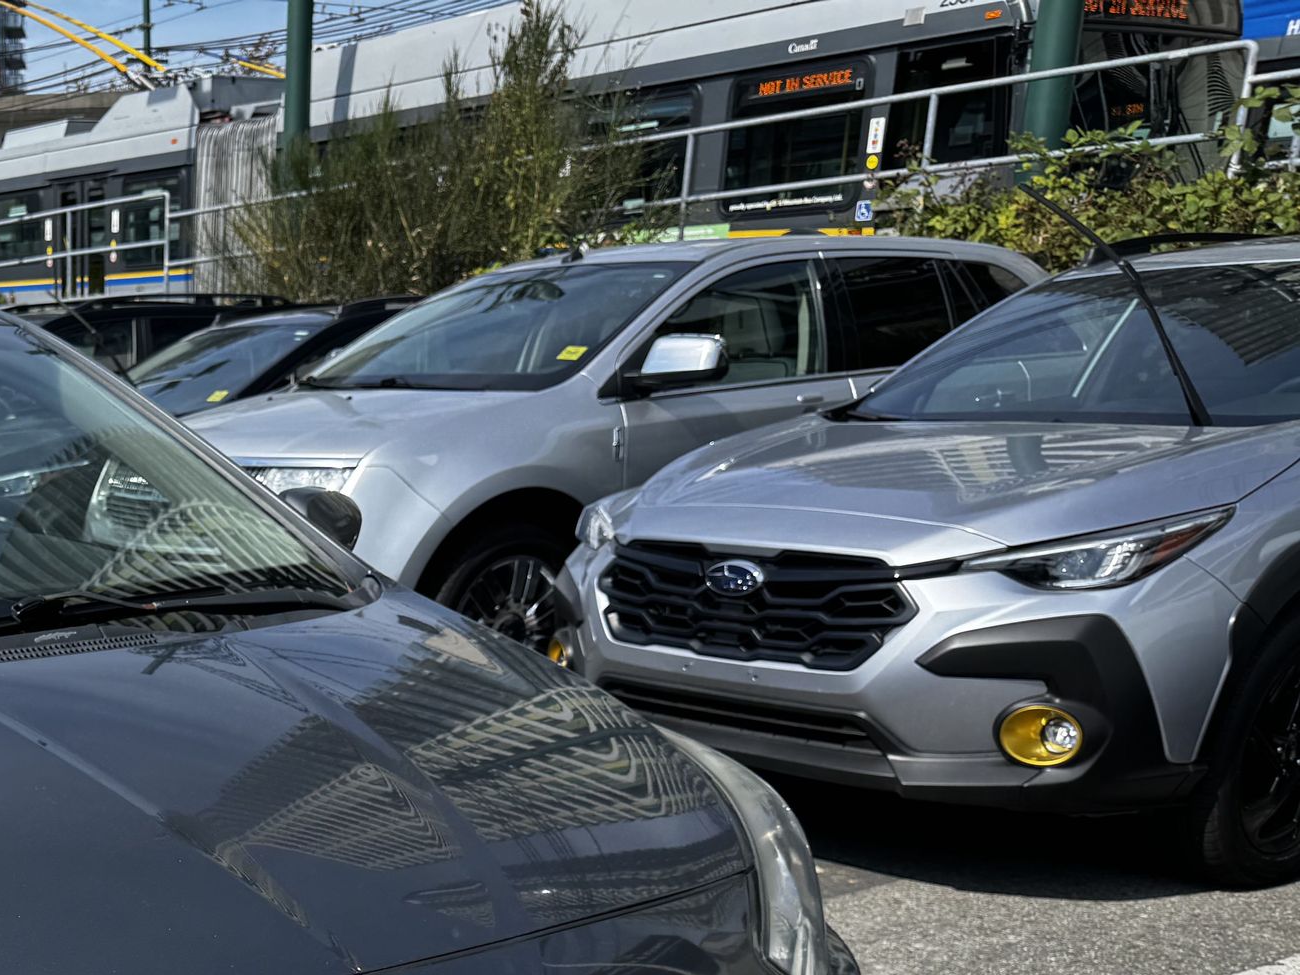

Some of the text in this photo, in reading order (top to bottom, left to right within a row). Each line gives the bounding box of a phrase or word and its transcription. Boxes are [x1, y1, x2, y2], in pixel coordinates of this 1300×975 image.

[788, 40, 818, 54] Canada
[758, 69, 853, 96] NOT IN SERVICE
